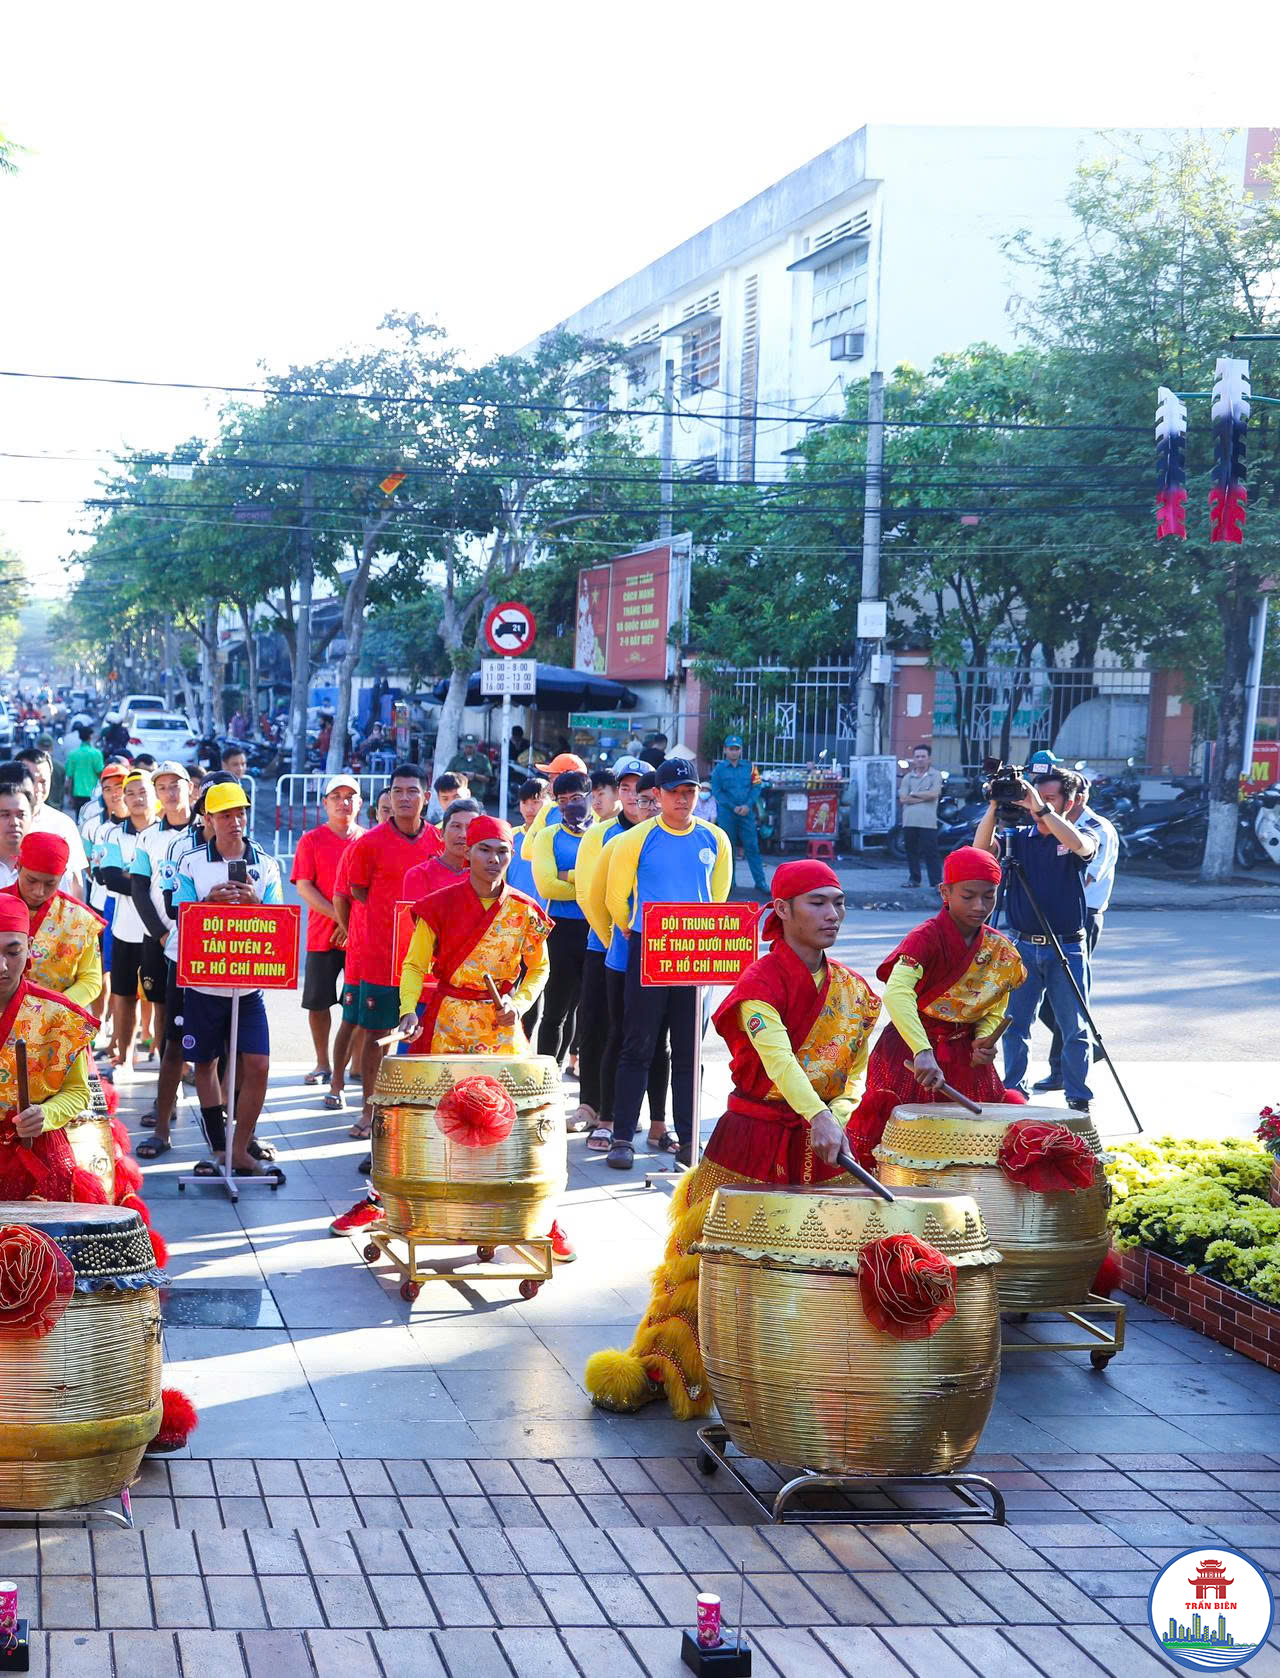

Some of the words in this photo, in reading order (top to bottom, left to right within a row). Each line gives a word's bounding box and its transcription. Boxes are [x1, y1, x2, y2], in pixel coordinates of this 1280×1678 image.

[203, 916, 224, 935] ĐỘI
[227, 916, 276, 934] PHƯỜNG
[661, 915, 679, 933] ĐỘI
[681, 917, 715, 930] TRUNG
[718, 915, 740, 930] TÂM
[202, 937, 226, 953] TÂN
[229, 938, 261, 955] UYÊN
[264, 942, 276, 957] 2,
[648, 933, 667, 951] THỂ
[669, 938, 695, 951] THAO
[698, 936, 722, 951] DƯỚI
[725, 936, 753, 952] NƯỚC
[190, 960, 206, 974] TP.
[210, 957, 226, 975] HỒ
[230, 960, 250, 975] CHÍ
[253, 963, 286, 976] MINH
[660, 959, 674, 973] TP.
[676, 955, 690, 973] HỒ
[693, 957, 710, 973] CHÍ
[713, 960, 740, 973] MINH
